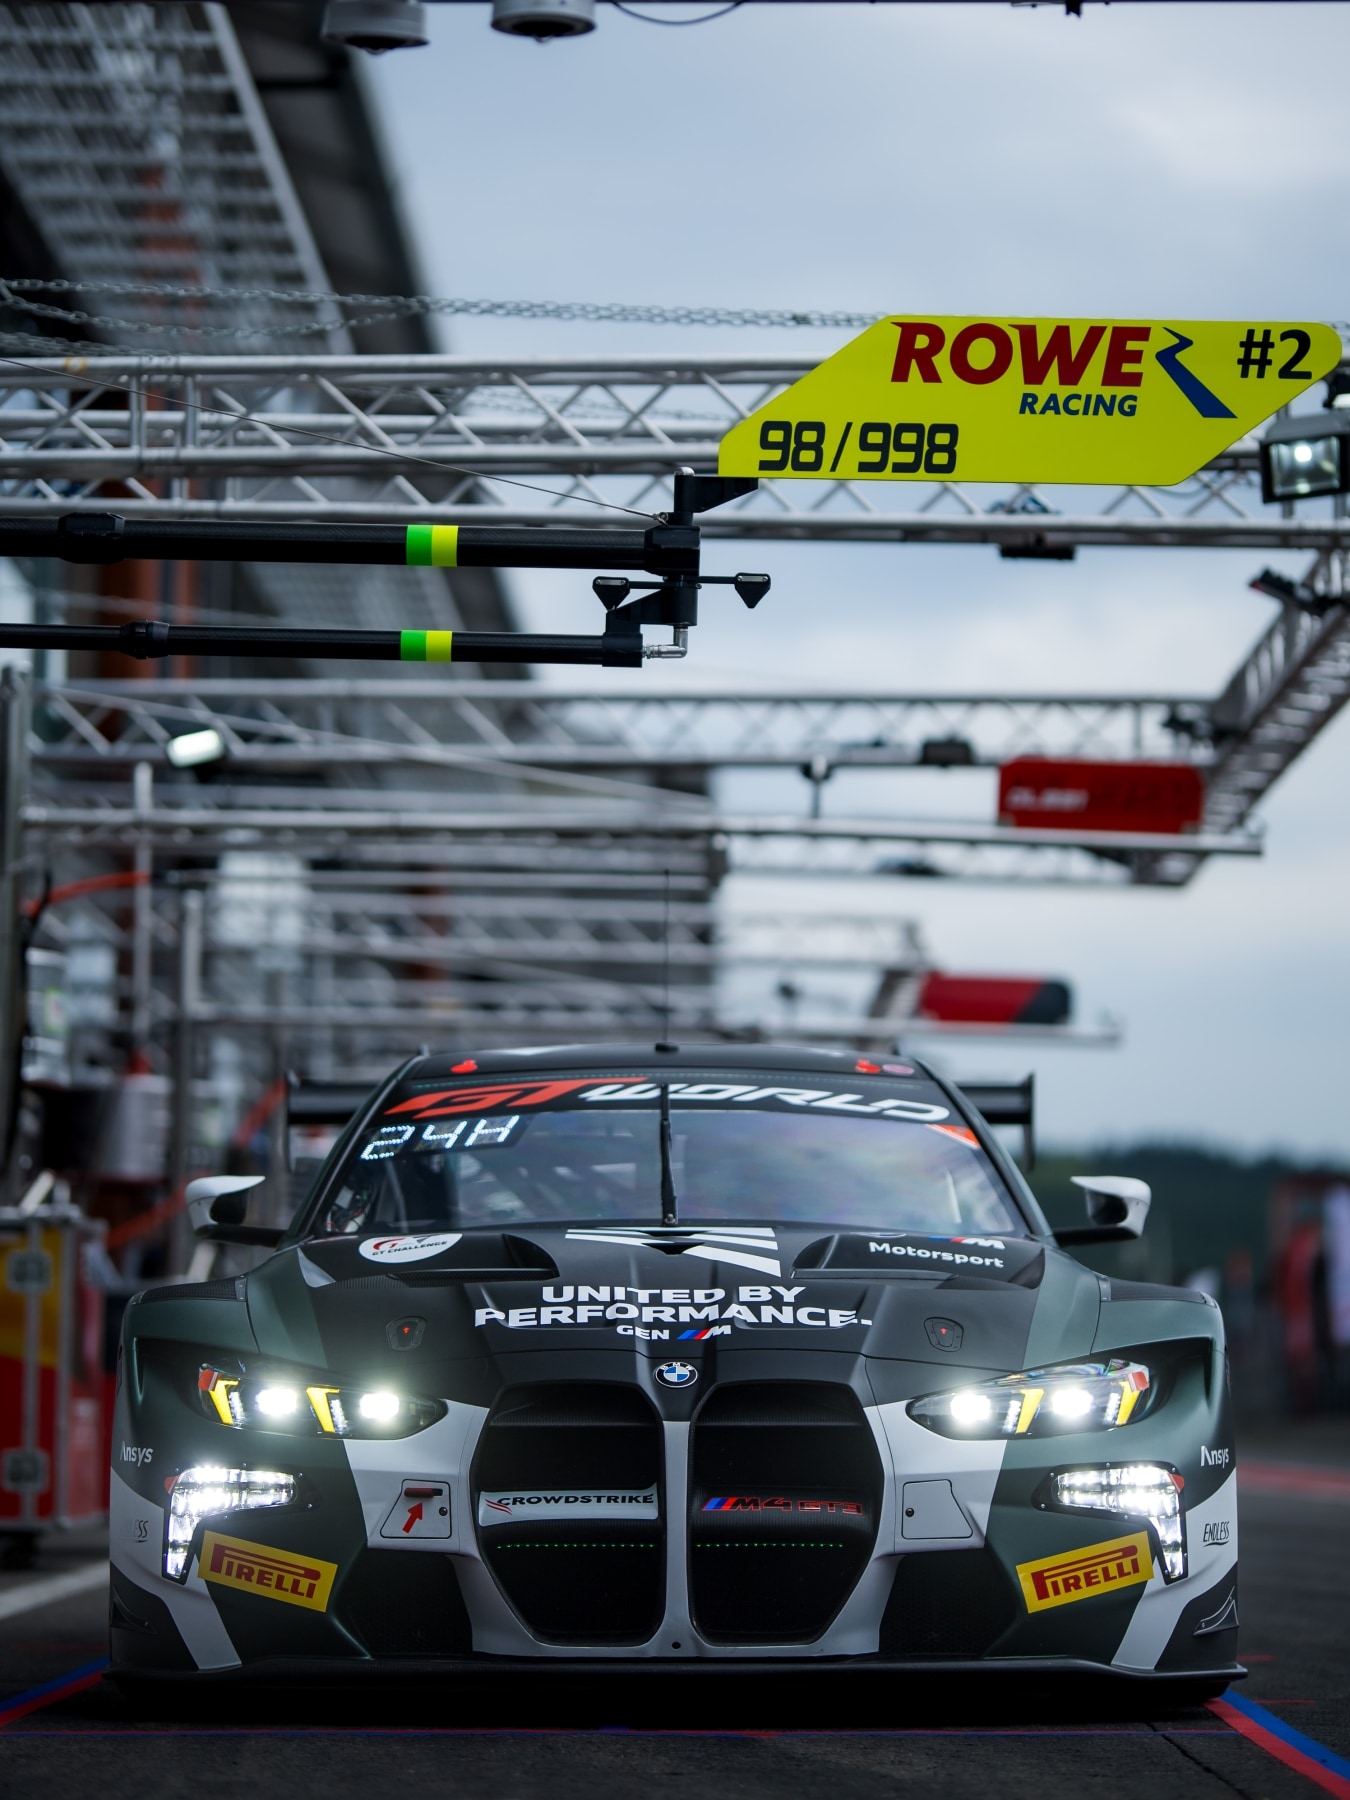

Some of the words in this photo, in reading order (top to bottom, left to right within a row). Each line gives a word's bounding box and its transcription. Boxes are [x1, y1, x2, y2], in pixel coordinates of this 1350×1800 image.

[890, 322, 1151, 387] ROWE
[1237, 328, 1312, 380] #2
[1018, 392, 1138, 417] RACING
[578, 1083, 950, 1121] WORLD
[360, 1114, 520, 1160] 24H
[388, 1240, 448, 1254] CHALLENGE
[868, 1241, 1004, 1268] Motorsport
[542, 1285, 726, 1303] UNITED
[738, 1285, 806, 1302] BY
[474, 1302, 873, 1328] PERFORMANCE.
[616, 1325, 669, 1340] GEN
[120, 1442, 153, 1467] Ansys
[1200, 1445, 1230, 1469] Ansys
[496, 1493, 654, 1506] CROWDSTRIKE
[730, 1496, 793, 1511] M4
[798, 1499, 863, 1516] GT3
[1203, 1521, 1230, 1543] ENDLESS
[210, 1543, 322, 1600] PIRELLI
[1031, 1544, 1140, 1601] PIRELLI
